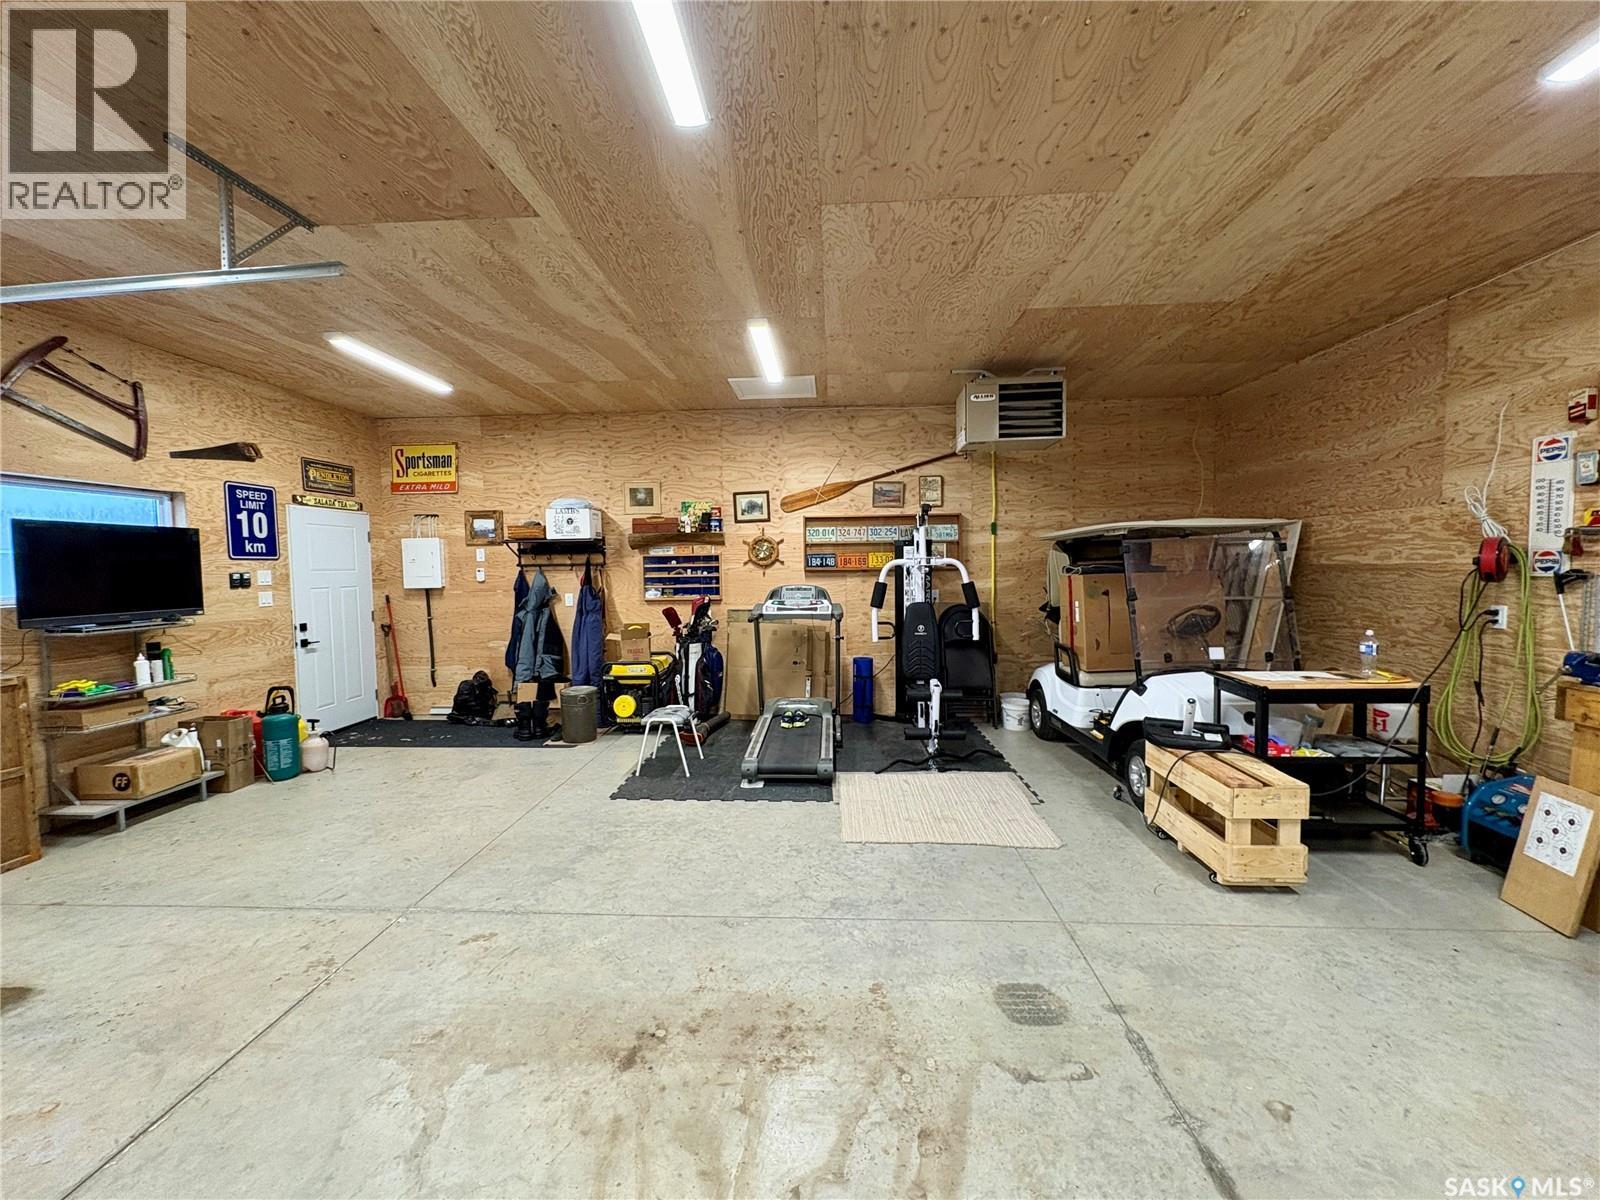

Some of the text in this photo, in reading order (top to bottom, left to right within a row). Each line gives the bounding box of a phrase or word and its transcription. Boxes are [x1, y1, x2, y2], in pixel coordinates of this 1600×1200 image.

[1539, 445, 1567, 454] PEPSI
[395, 448, 453, 478] Sportsman
[235, 489, 268, 501] SPEED
[240, 500, 265, 510] LIMIT
[313, 498, 336, 507] SALADA
[236, 510, 269, 539] 10
[245, 540, 266, 553] km
[115, 776, 128, 788] FF
